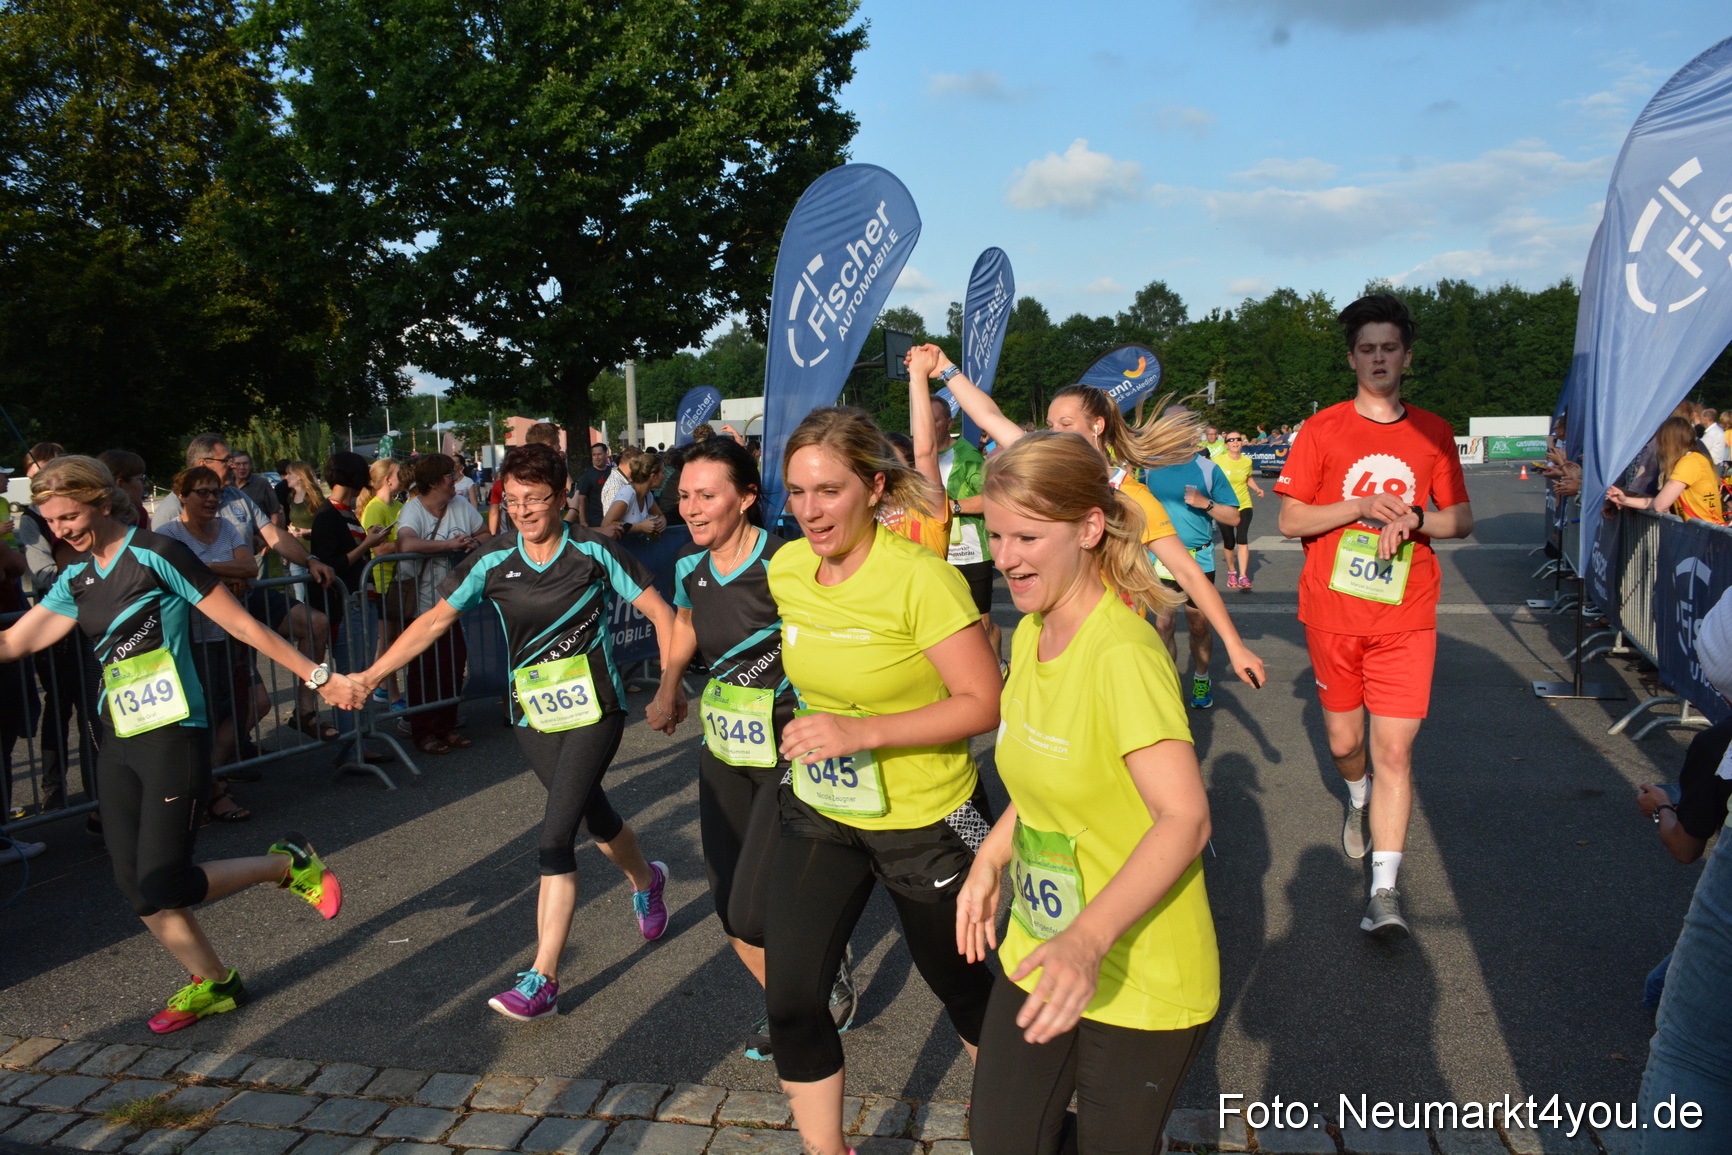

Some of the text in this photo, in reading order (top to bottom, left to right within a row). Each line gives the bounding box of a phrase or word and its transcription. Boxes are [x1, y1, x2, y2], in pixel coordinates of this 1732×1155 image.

[807, 200, 890, 343] Fischer
[837, 228, 899, 342] AUTOMOBILE
[1136, 374, 1157, 391] Medien
[686, 392, 712, 429] Fischer
[1351, 470, 1408, 502] 48
[1348, 556, 1394, 585] 504
[116, 615, 158, 659] Donauer
[549, 650, 561, 661] &
[114, 678, 174, 716] 1349
[528, 684, 589, 715] 1363
[706, 712, 766, 745] 1348
[806, 751, 859, 788] 645
[1016, 860, 1063, 919] 646
